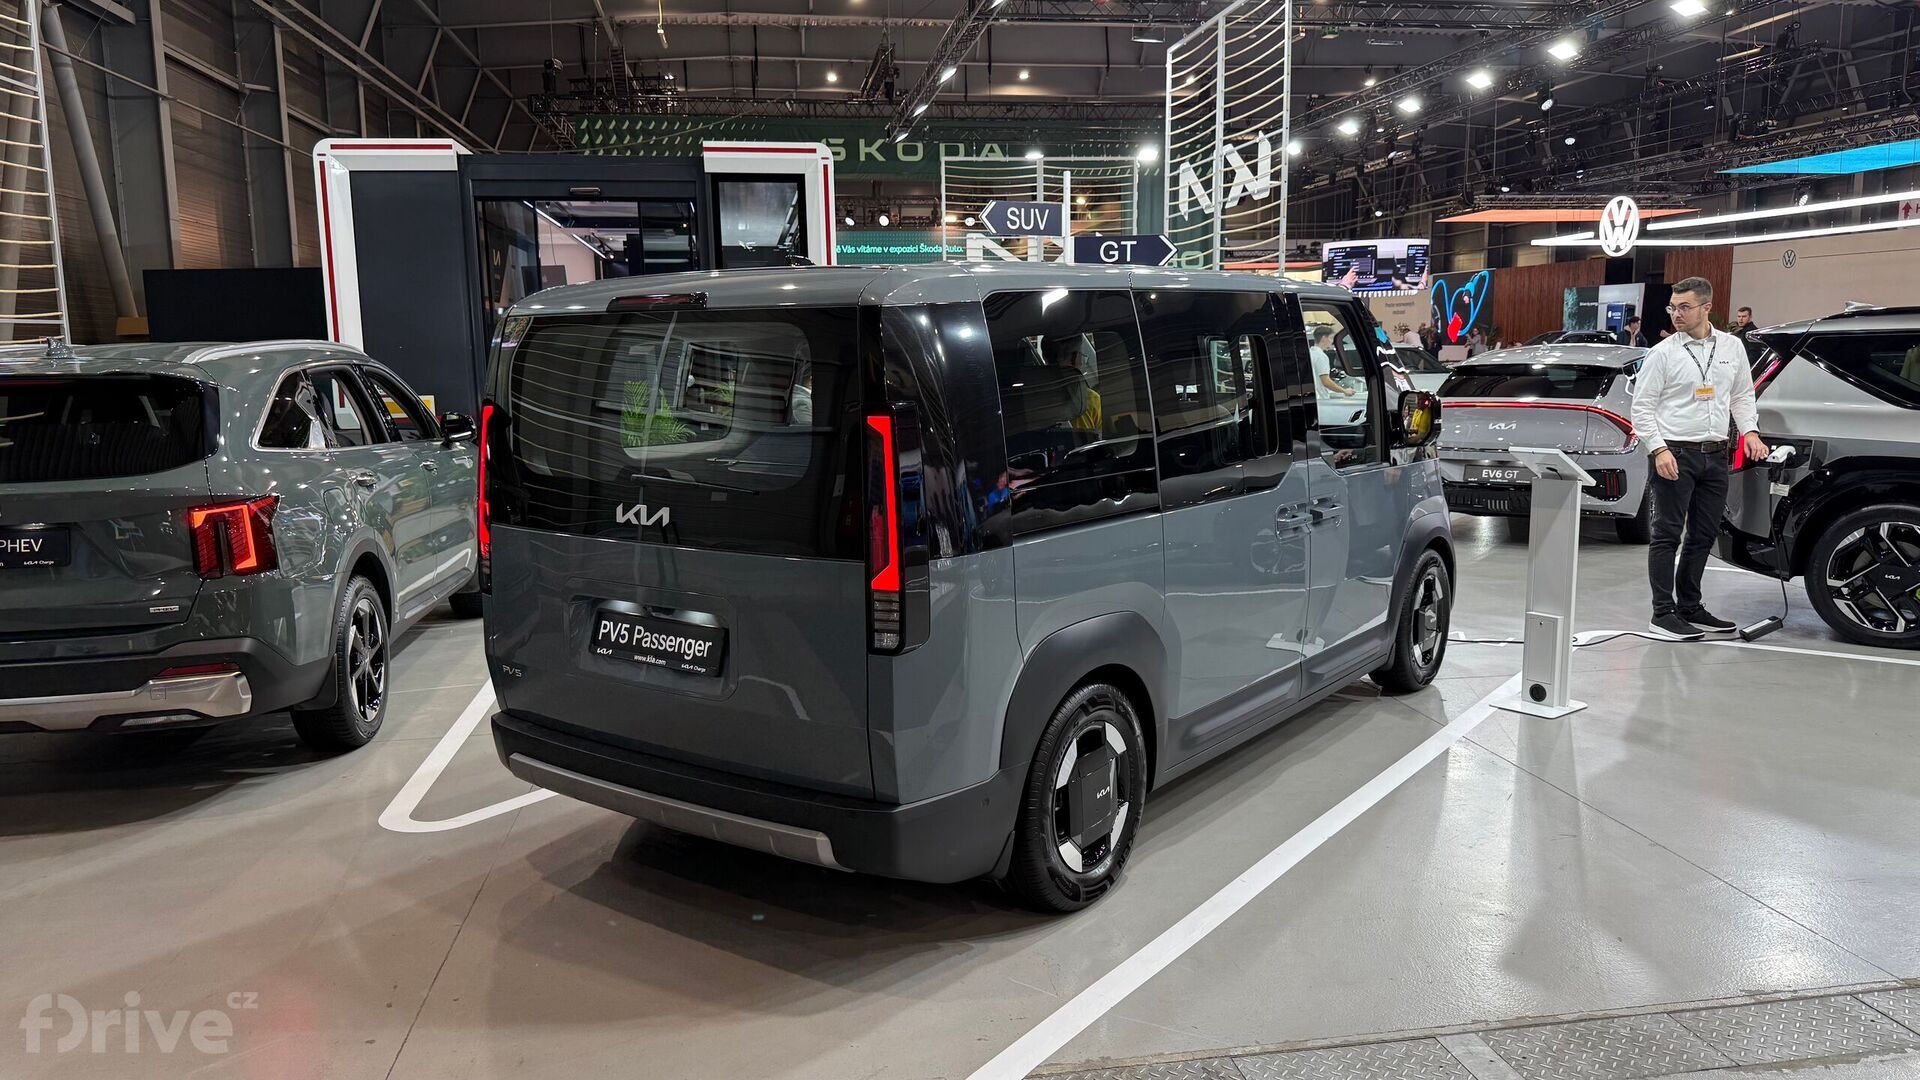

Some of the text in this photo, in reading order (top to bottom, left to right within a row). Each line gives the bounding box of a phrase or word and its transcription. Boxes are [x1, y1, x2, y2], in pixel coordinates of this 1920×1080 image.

[1006, 207, 1049, 230] SUV
[842, 244, 855, 253] Vás
[856, 244, 882, 253] vítáme
[889, 244, 918, 255] expozici
[919, 243, 942, 253] Škoda
[1098, 240, 1137, 262] GT
[1482, 469, 1519, 479] EV6 GT
[598, 620, 713, 661] PV5 Passenger
[634, 654, 667, 666] www.kia.com
[502, 664, 522, 678] PV5
